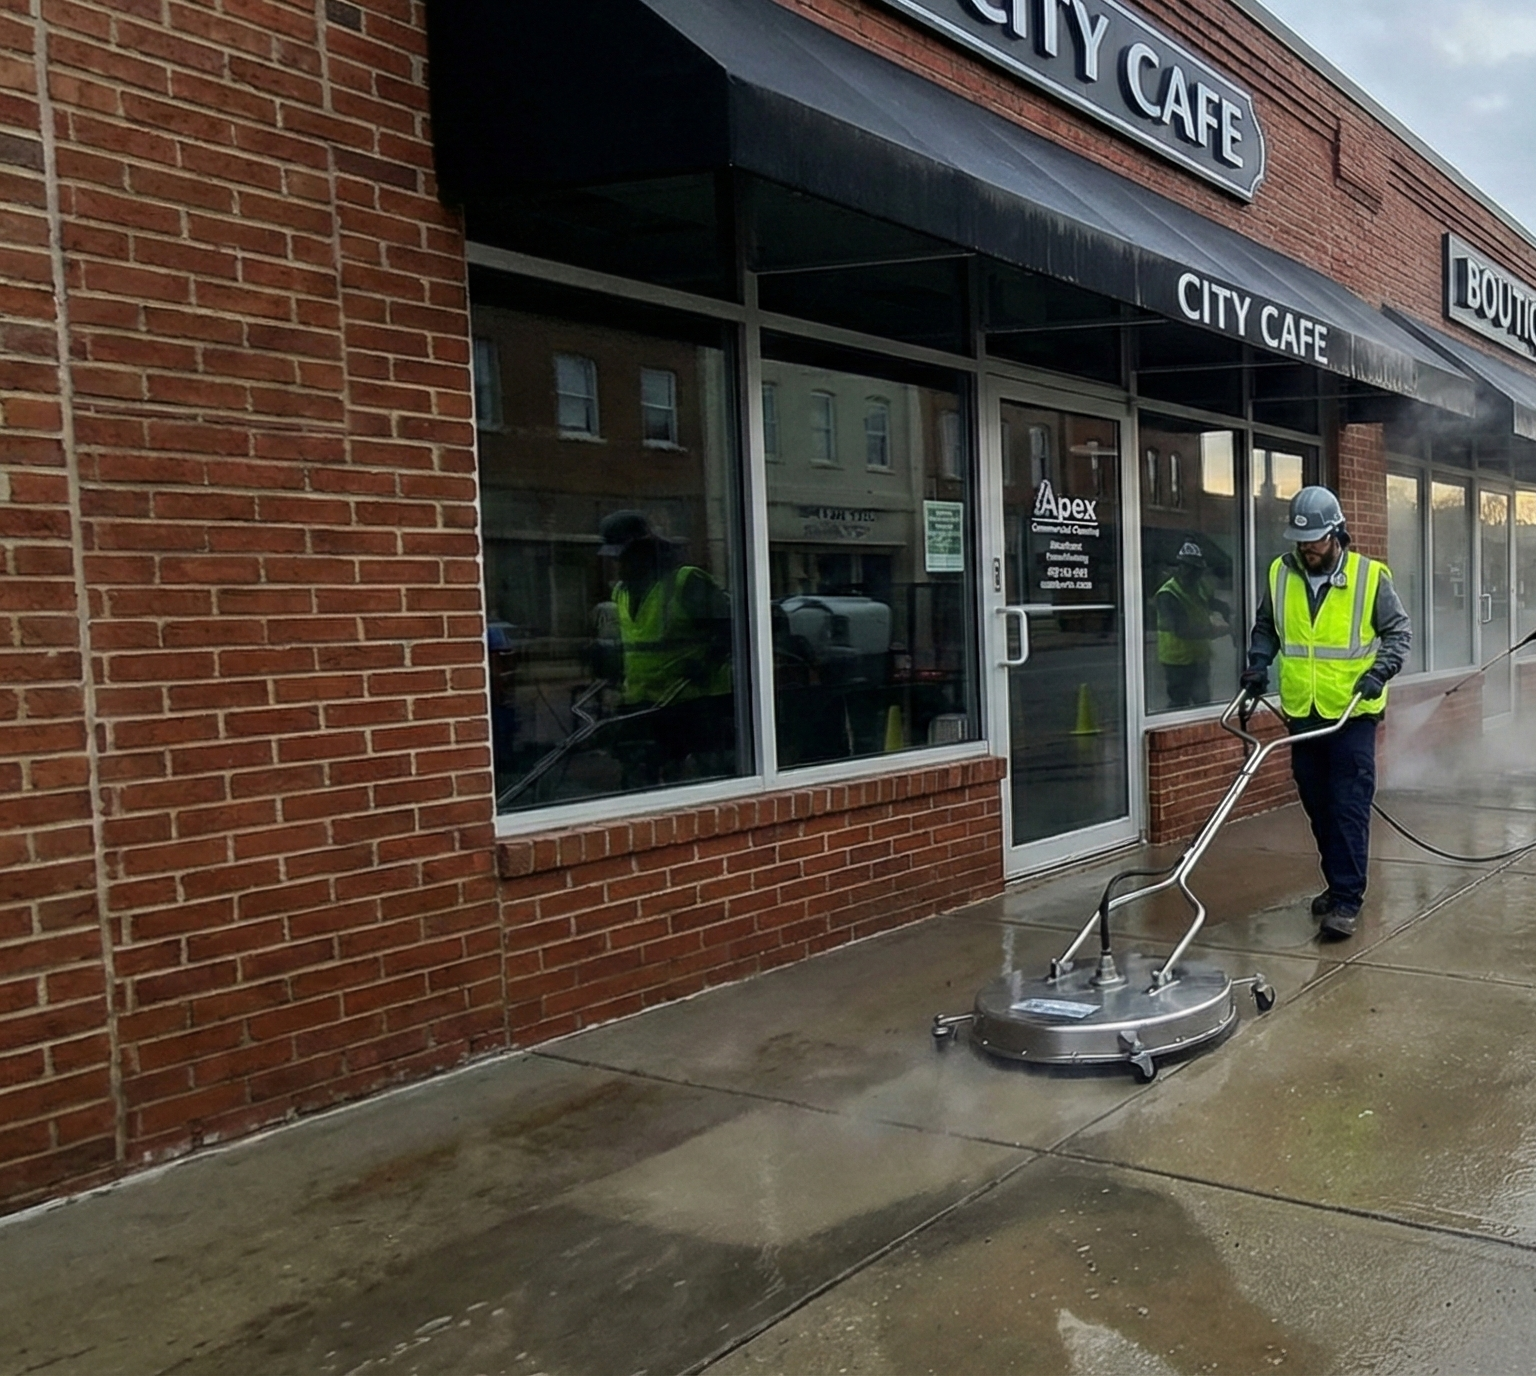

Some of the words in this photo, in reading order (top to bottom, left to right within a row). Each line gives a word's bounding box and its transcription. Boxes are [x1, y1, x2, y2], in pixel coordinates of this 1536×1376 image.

[1126, 43, 1244, 168] CAFE
[1177, 273, 1251, 336] CITY
[1260, 305, 1328, 365] CAFE
[1038, 480, 1097, 521] Apex
